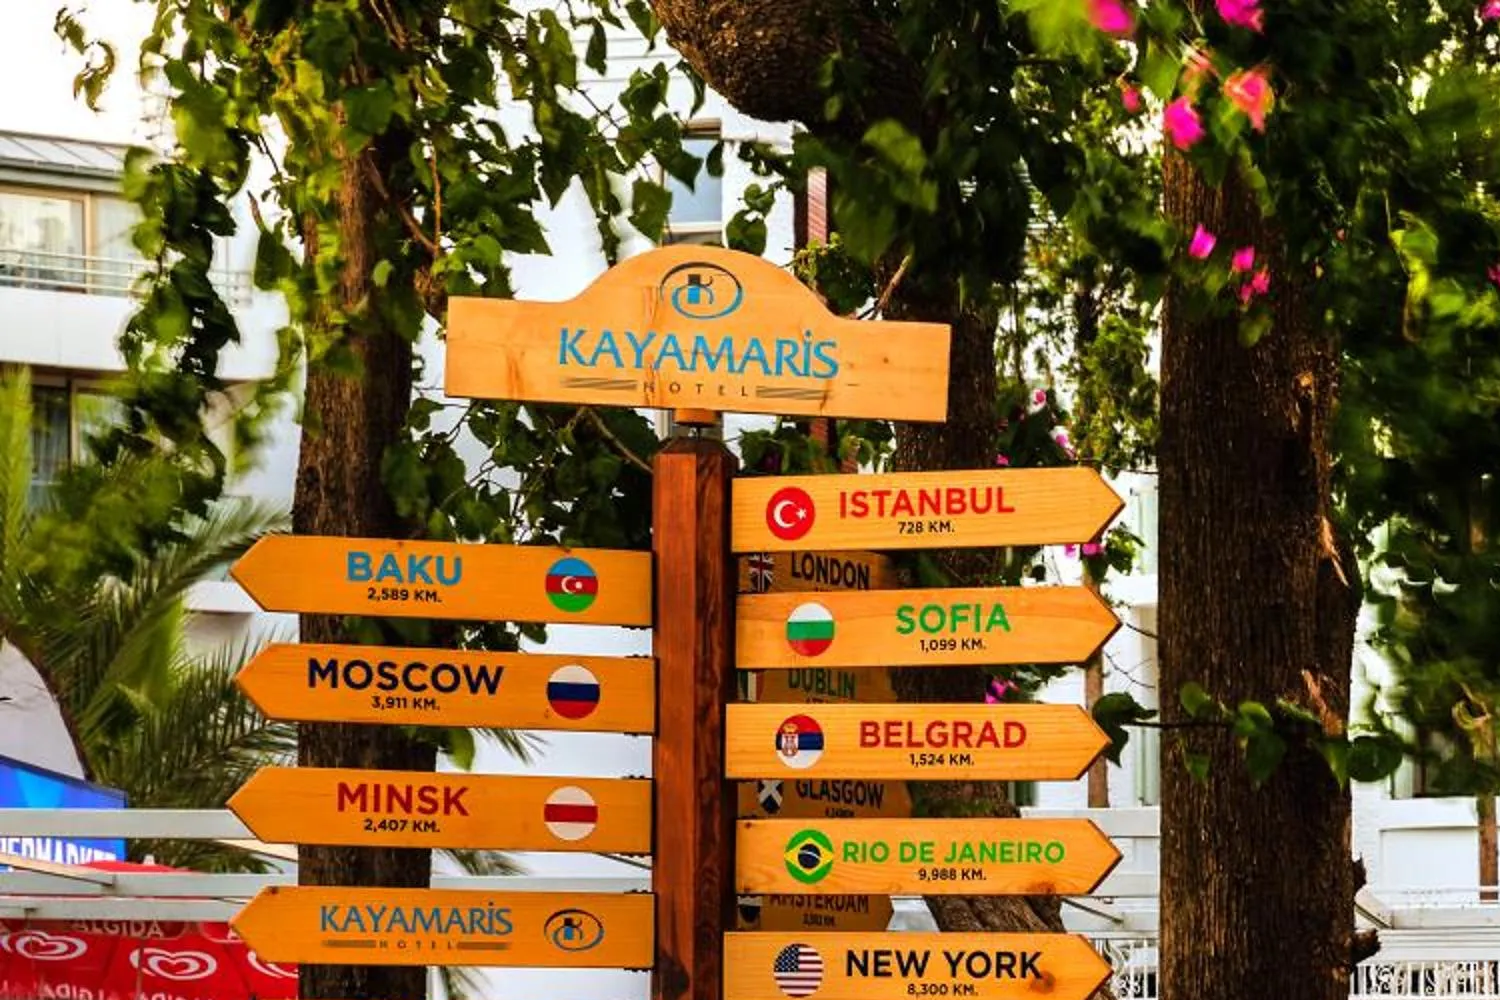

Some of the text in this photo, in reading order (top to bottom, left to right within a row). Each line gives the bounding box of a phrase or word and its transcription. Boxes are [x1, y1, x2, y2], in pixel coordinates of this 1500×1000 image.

[840, 486, 1015, 518] ISTANBUL
[898, 520, 954, 534] 728 KM.
[346, 551, 462, 586] BAKU
[792, 552, 870, 590] LONDON
[368, 587, 442, 602] 2,589 KM.
[895, 604, 1012, 635] SOFIA
[920, 638, 987, 652] 1,099 KM.
[308, 658, 504, 695] MOSCOW
[788, 668, 856, 698] DUBLIN
[371, 696, 440, 710] 3,911 KM.
[859, 721, 1027, 749] BELGRAD
[910, 753, 974, 767] 1,524 KM.
[337, 782, 470, 815] MINSK
[796, 780, 885, 809] GLASGOW
[364, 819, 440, 833] 2,407 KM.
[843, 841, 1065, 864] RIO DE JANEIRO
[918, 868, 987, 882] 9,988 KM.
[846, 950, 1043, 979] NEW YORK
[907, 983, 978, 997] 8,300 KM.
